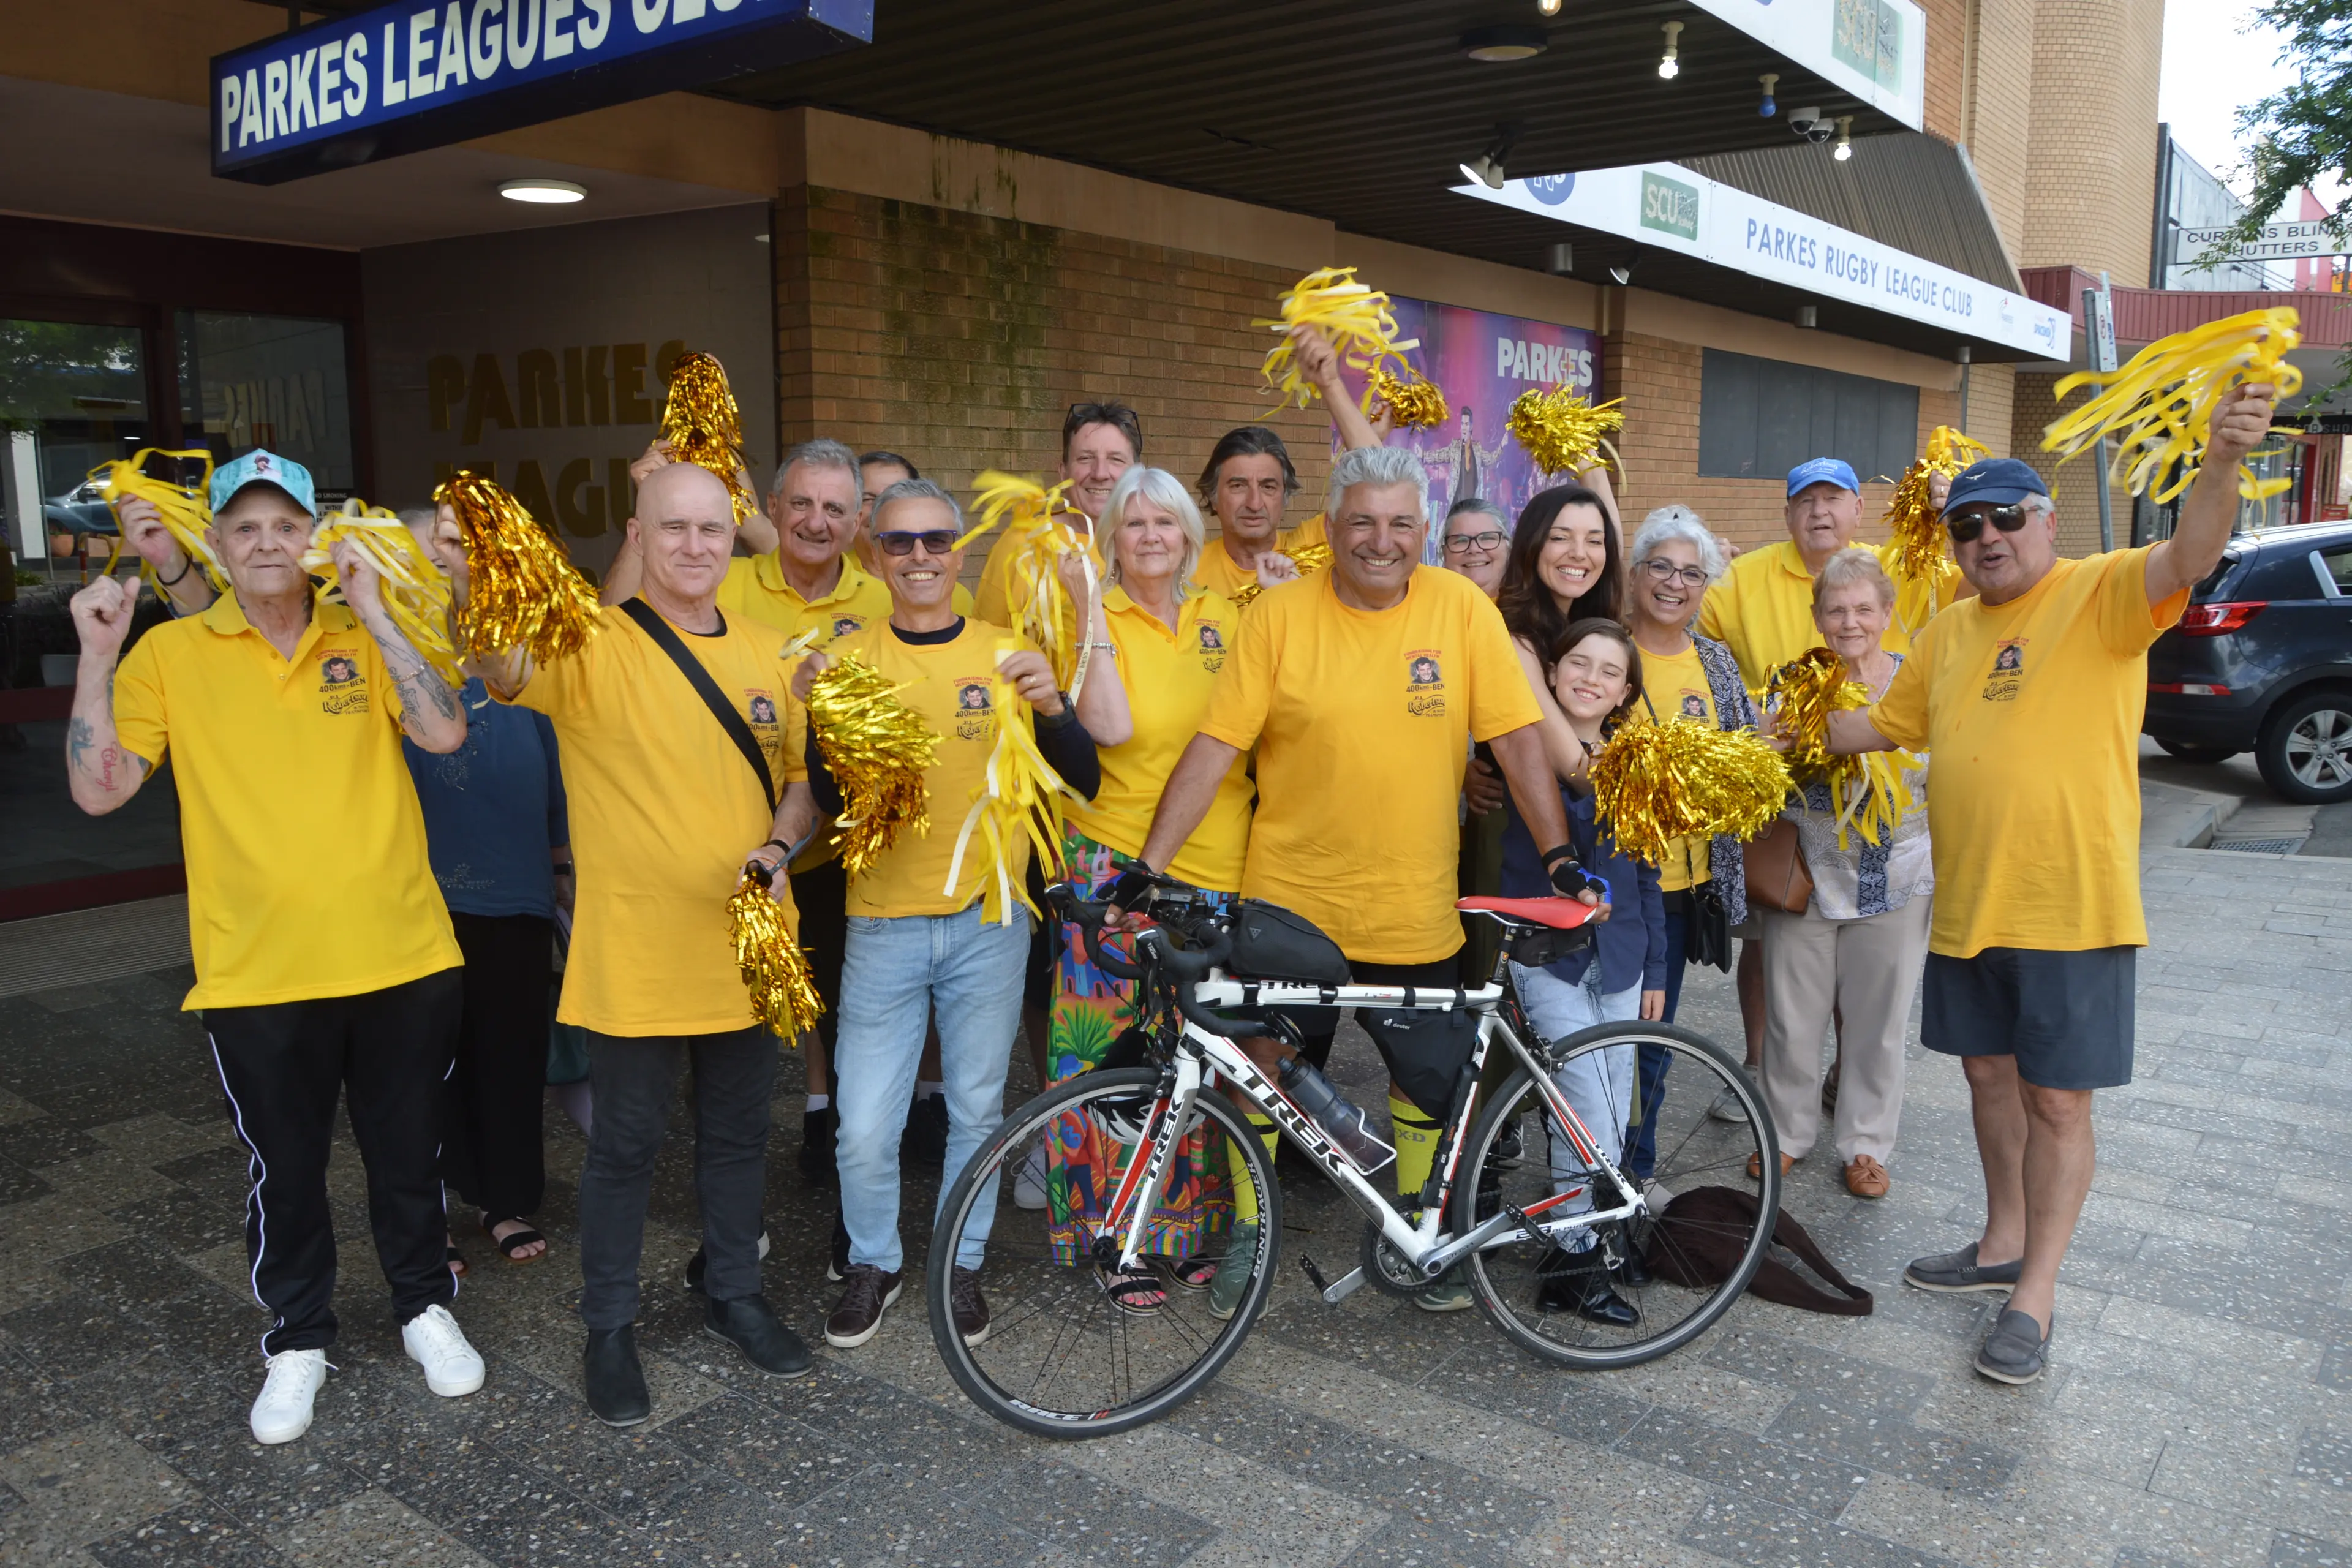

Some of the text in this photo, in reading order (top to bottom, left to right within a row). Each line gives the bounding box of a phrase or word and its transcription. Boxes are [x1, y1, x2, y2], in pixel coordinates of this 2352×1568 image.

[221, 0, 612, 152] PARKES LEAGUES
[1646, 184, 1679, 224] SCU
[2187, 228, 2278, 243] CURNS
[1747, 219, 1973, 317] PARKES RUGBY LEAGUE CLUB
[1498, 337, 1593, 387] PARKES
[319, 684, 346, 693] 400kms
[350, 677, 366, 687] BEN
[1408, 696, 1445, 715] Robertson
[1243, 1061, 1349, 1177] TREK
[1146, 1098, 1186, 1182] TREK
[1594, 1144, 1627, 1183] TREK
[1247, 1161, 1266, 1278] BONTRAGER
[1552, 1224, 1583, 1233] ALPHA
[1009, 1399, 1082, 1420] RACE
